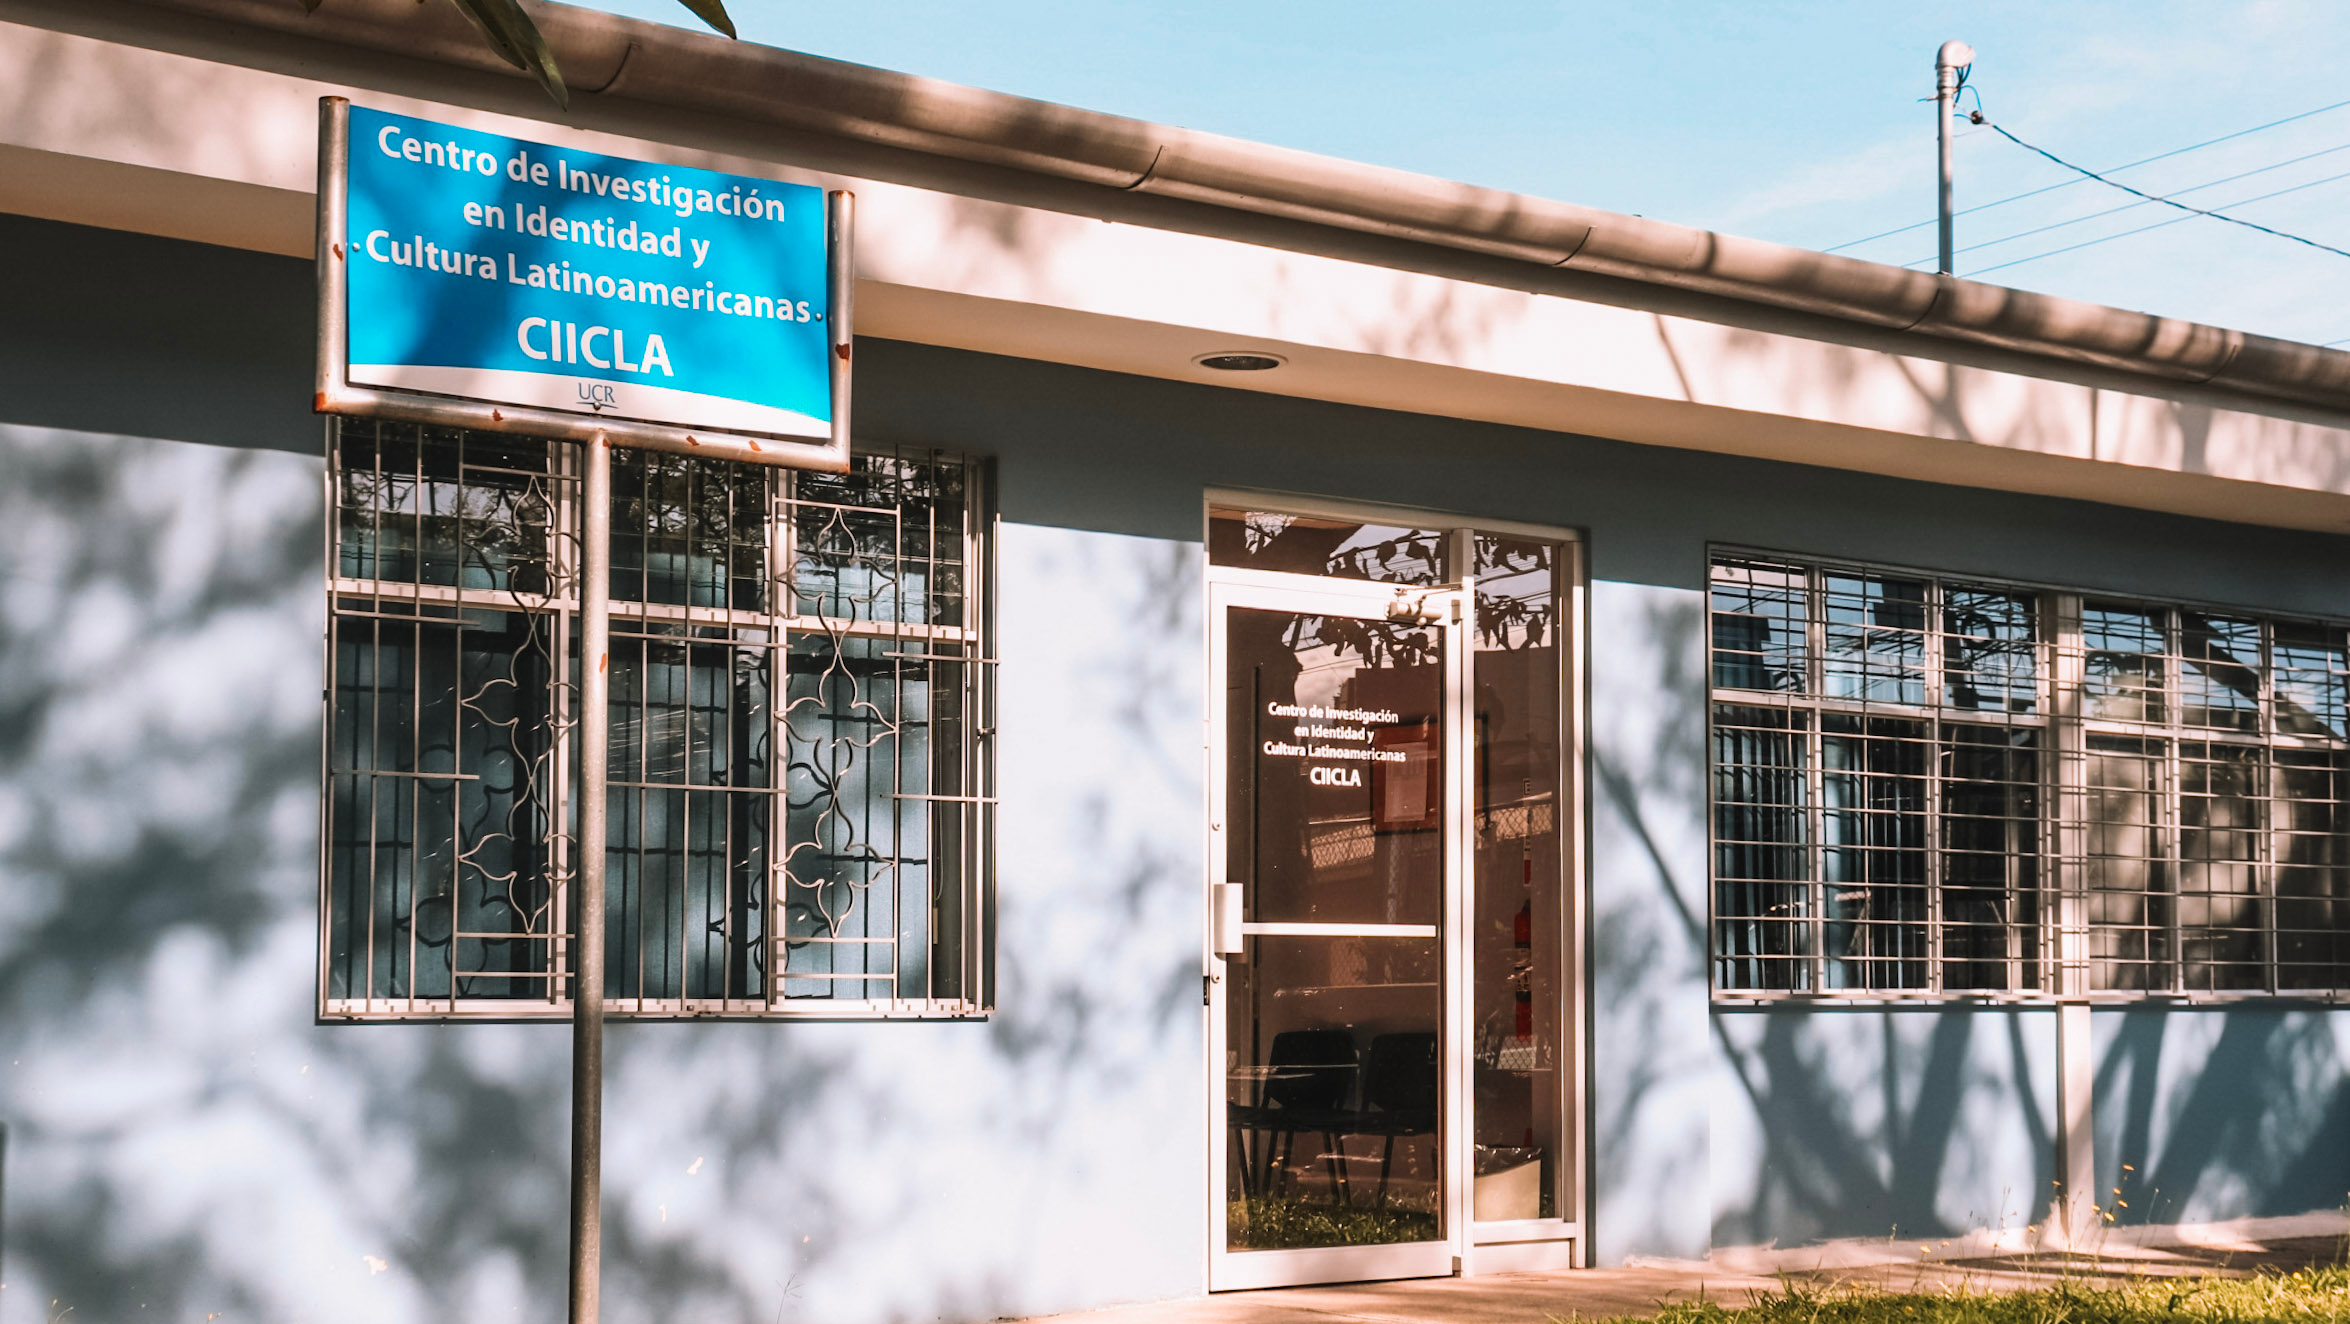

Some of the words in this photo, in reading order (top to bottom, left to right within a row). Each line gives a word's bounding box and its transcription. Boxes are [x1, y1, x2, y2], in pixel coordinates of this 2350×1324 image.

[378, 125, 498, 177] Centro
[506, 150, 549, 186] de
[559, 159, 785, 223] Investigación
[463, 201, 505, 230] en
[516, 203, 682, 258] Identidad
[690, 238, 711, 269] y
[365, 229, 497, 280] Cultura
[508, 253, 811, 323] Latinoamericanas
[517, 316, 675, 377] CIICLA
[578, 382, 616, 403] UCR
[1268, 701, 1307, 718] Centro
[1309, 704, 1325, 719] de
[1326, 705, 1399, 725] Investigación
[1294, 726, 1310, 737] en
[1311, 724, 1366, 741] Identidad
[1367, 730, 1375, 744] y
[1263, 741, 1306, 757] Cultura
[1308, 744, 1406, 762] Latinoamericanas
[1310, 766, 1362, 787] CIICLA
